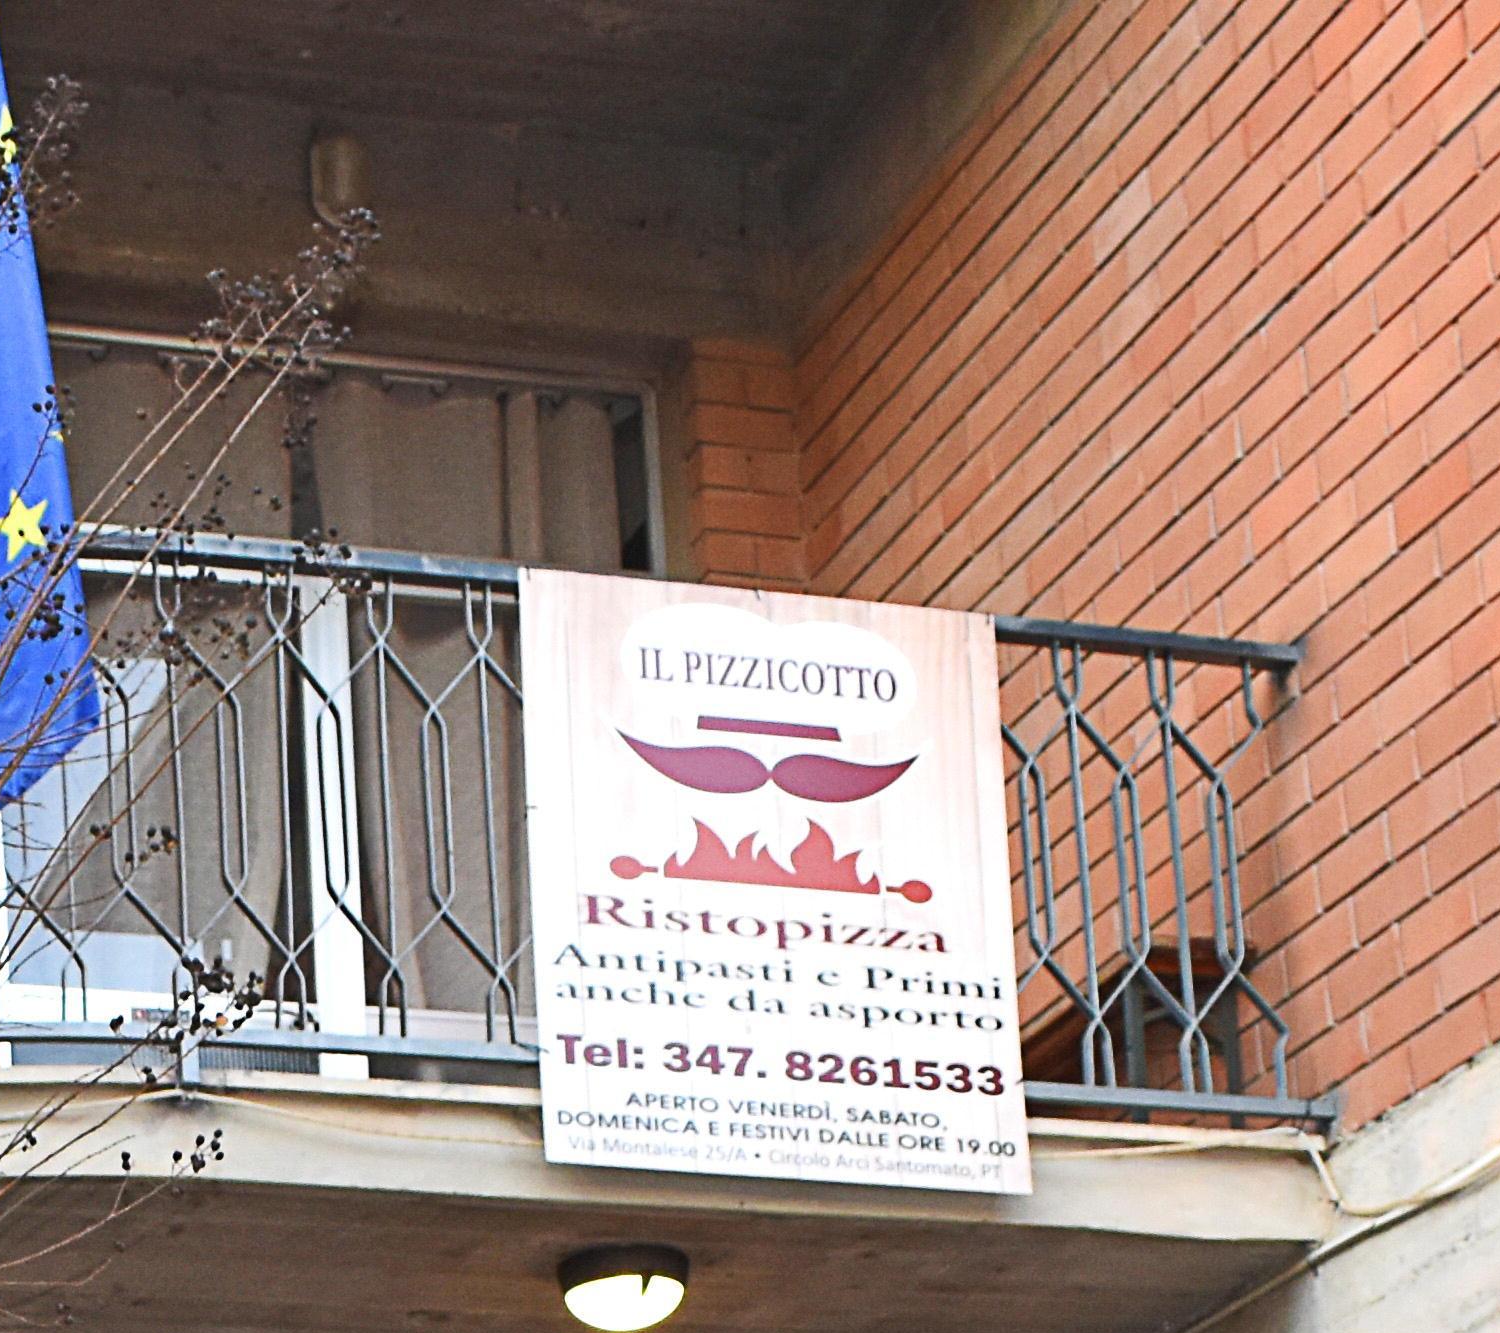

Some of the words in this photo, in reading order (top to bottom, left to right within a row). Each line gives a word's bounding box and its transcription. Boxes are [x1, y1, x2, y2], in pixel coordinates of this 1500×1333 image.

[639, 645, 675, 682] IL
[683, 650, 898, 703] PIZZICOTTO
[584, 892, 948, 955] Ristopizza
[553, 943, 796, 987] Antipasti
[816, 966, 842, 987] e
[864, 964, 1004, 1001] Primi
[556, 979, 707, 1012] anche
[727, 987, 785, 1015] da
[809, 997, 1004, 1033] asporto
[556, 1033, 645, 1071] Tel:
[662, 1041, 768, 1080] 347.
[784, 1049, 1005, 1097] 8261533
[557, 1109, 699, 1135] DOMENICA
[709, 1120, 720, 1137] E
[729, 1125, 810, 1144] FESTIVI
[819, 1128, 890, 1149] DALLE
[898, 1132, 946, 1152] ORE
[958, 1137, 1017, 1157] 19.00
[626, 1091, 719, 1114] APERTO
[728, 1099, 838, 1122] VENERDÌ,
[846, 1107, 949, 1131] SABATO,
[568, 1135, 596, 1151] Via
[602, 1137, 698, 1159] Montalese
[768, 1148, 831, 1169] Circolo
[836, 1154, 870, 1170] Arci
